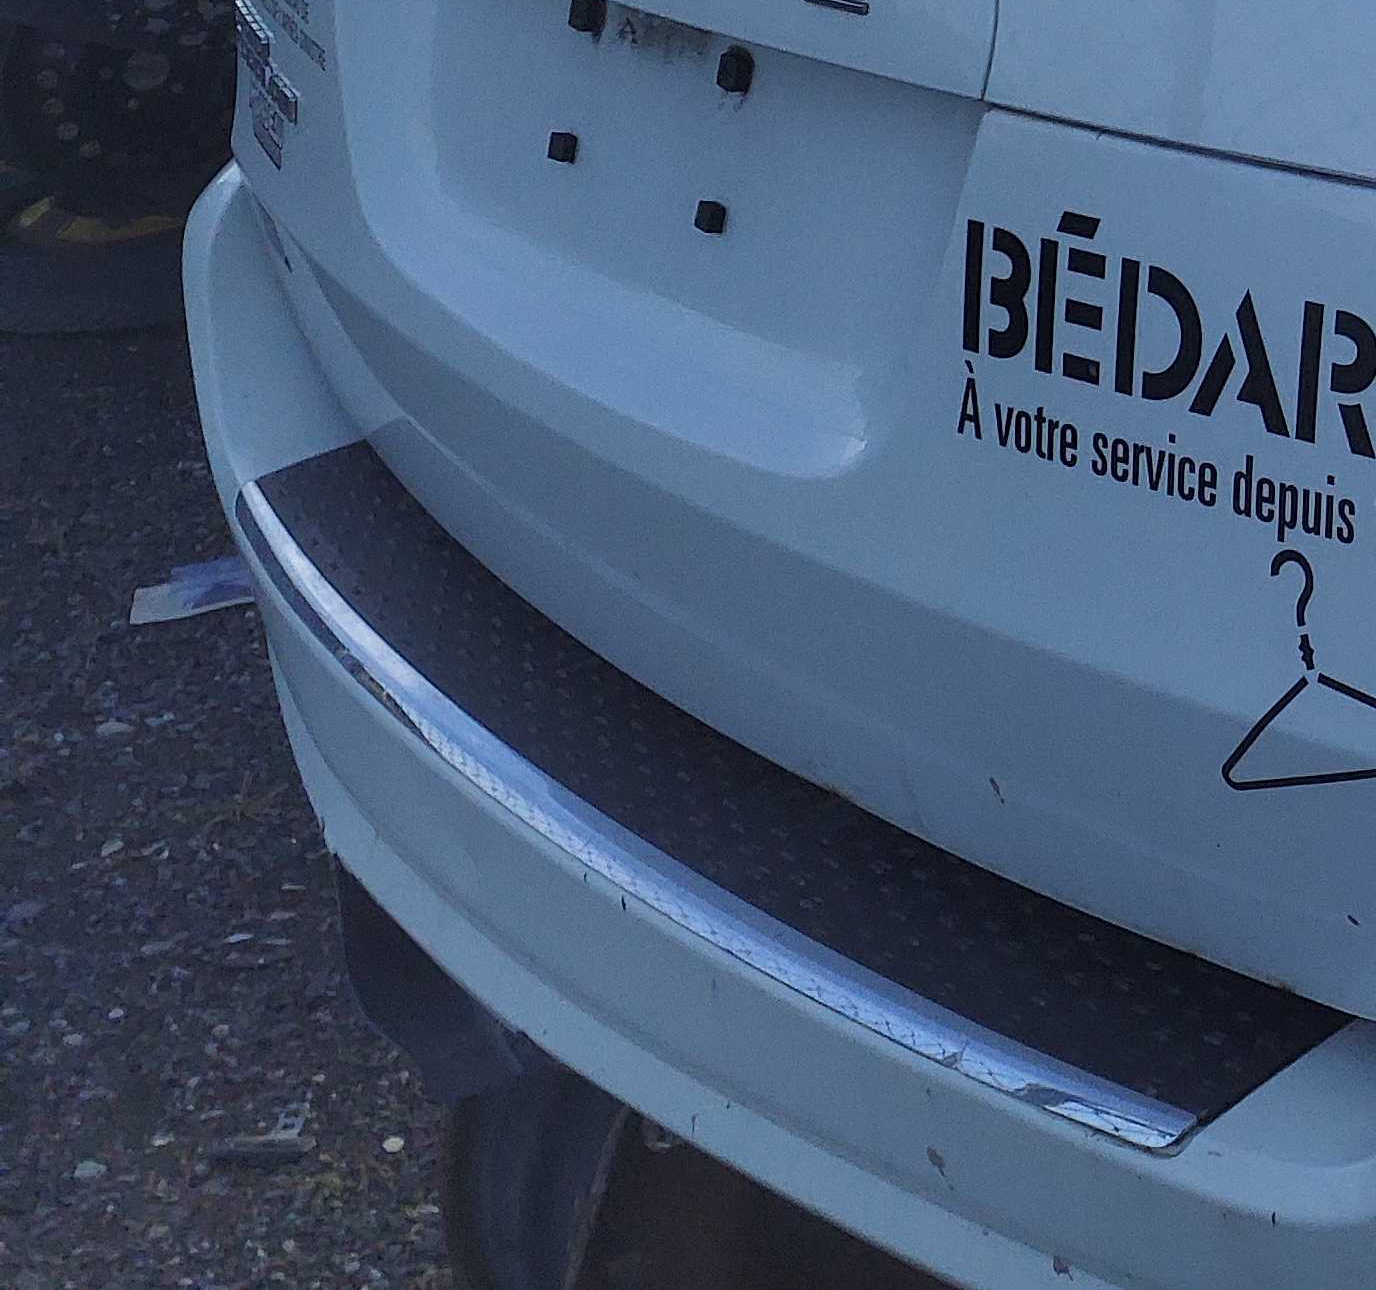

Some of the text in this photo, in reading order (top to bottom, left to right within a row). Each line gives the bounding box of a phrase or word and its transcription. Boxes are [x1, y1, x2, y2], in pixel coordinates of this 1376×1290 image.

[957, 360, 983, 440] À
[994, 402, 1078, 468] votre
[1091, 432, 1217, 507] service
[1232, 455, 1356, 545] depuis
